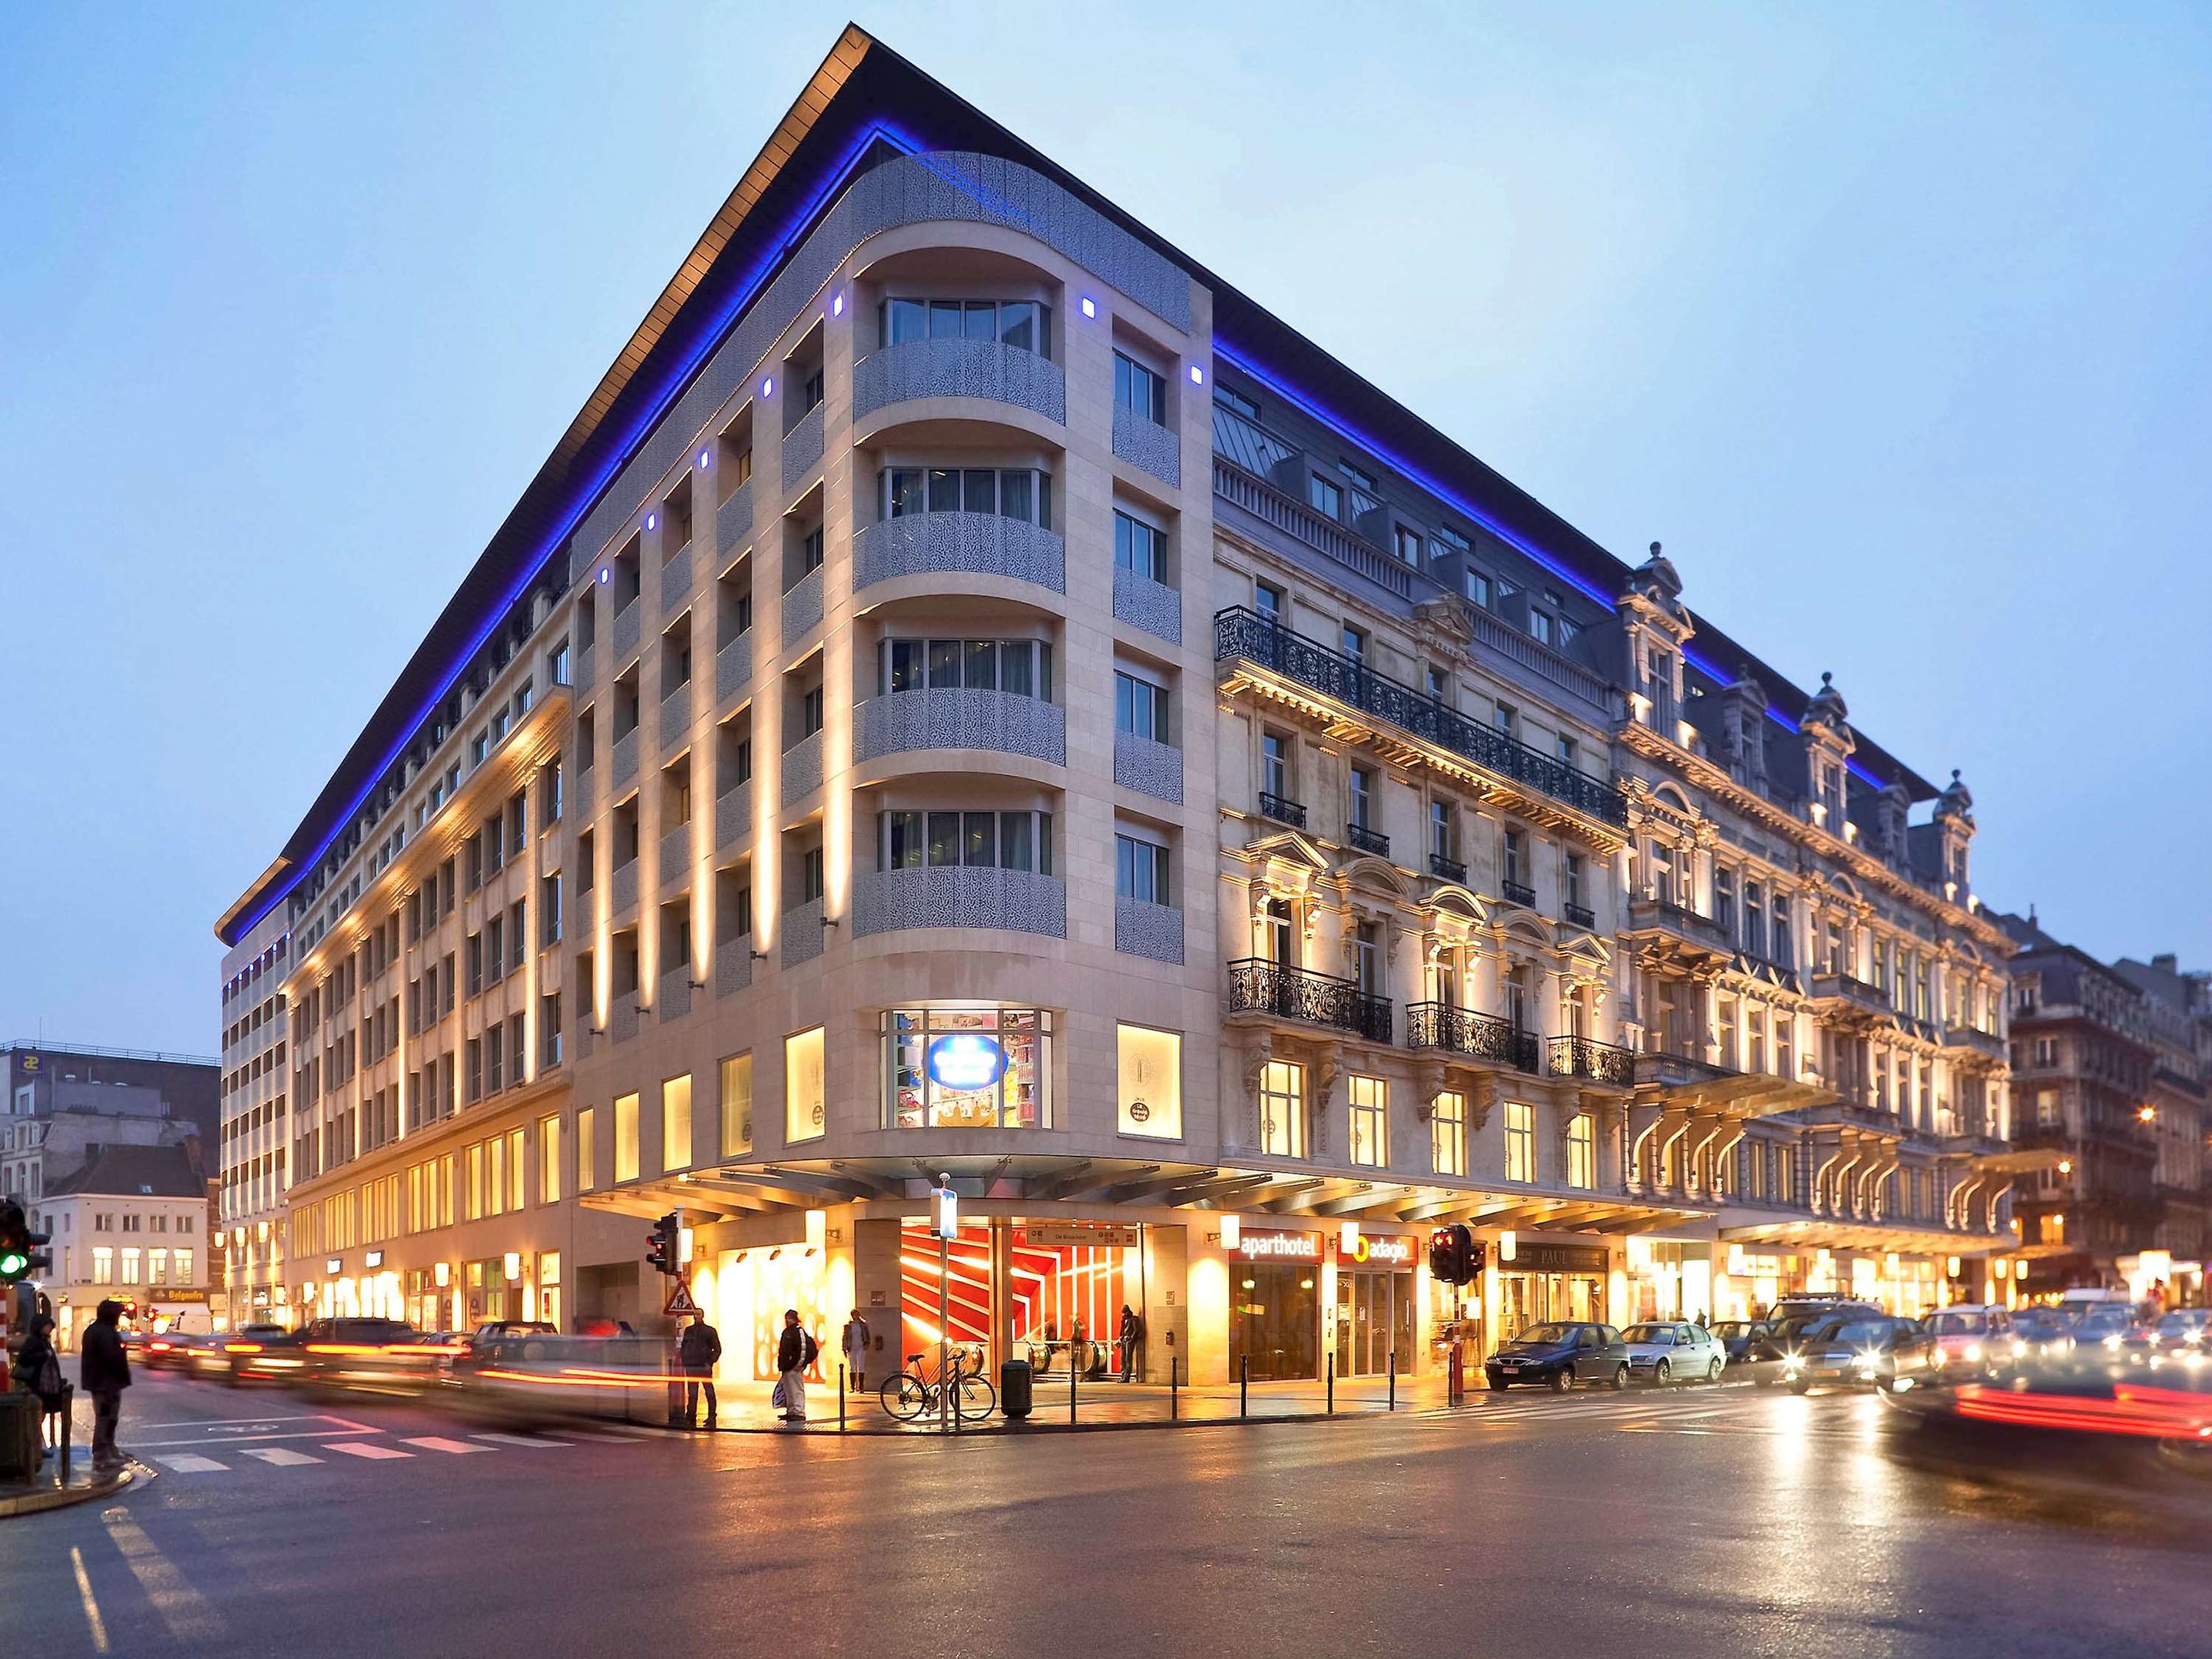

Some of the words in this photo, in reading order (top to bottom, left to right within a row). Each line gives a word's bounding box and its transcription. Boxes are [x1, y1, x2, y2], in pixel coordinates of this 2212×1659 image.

[1241, 1233, 1316, 1260] aparthotel
[1369, 1237, 1408, 1263] adagio
[1541, 1250, 1568, 1264] PAUL
